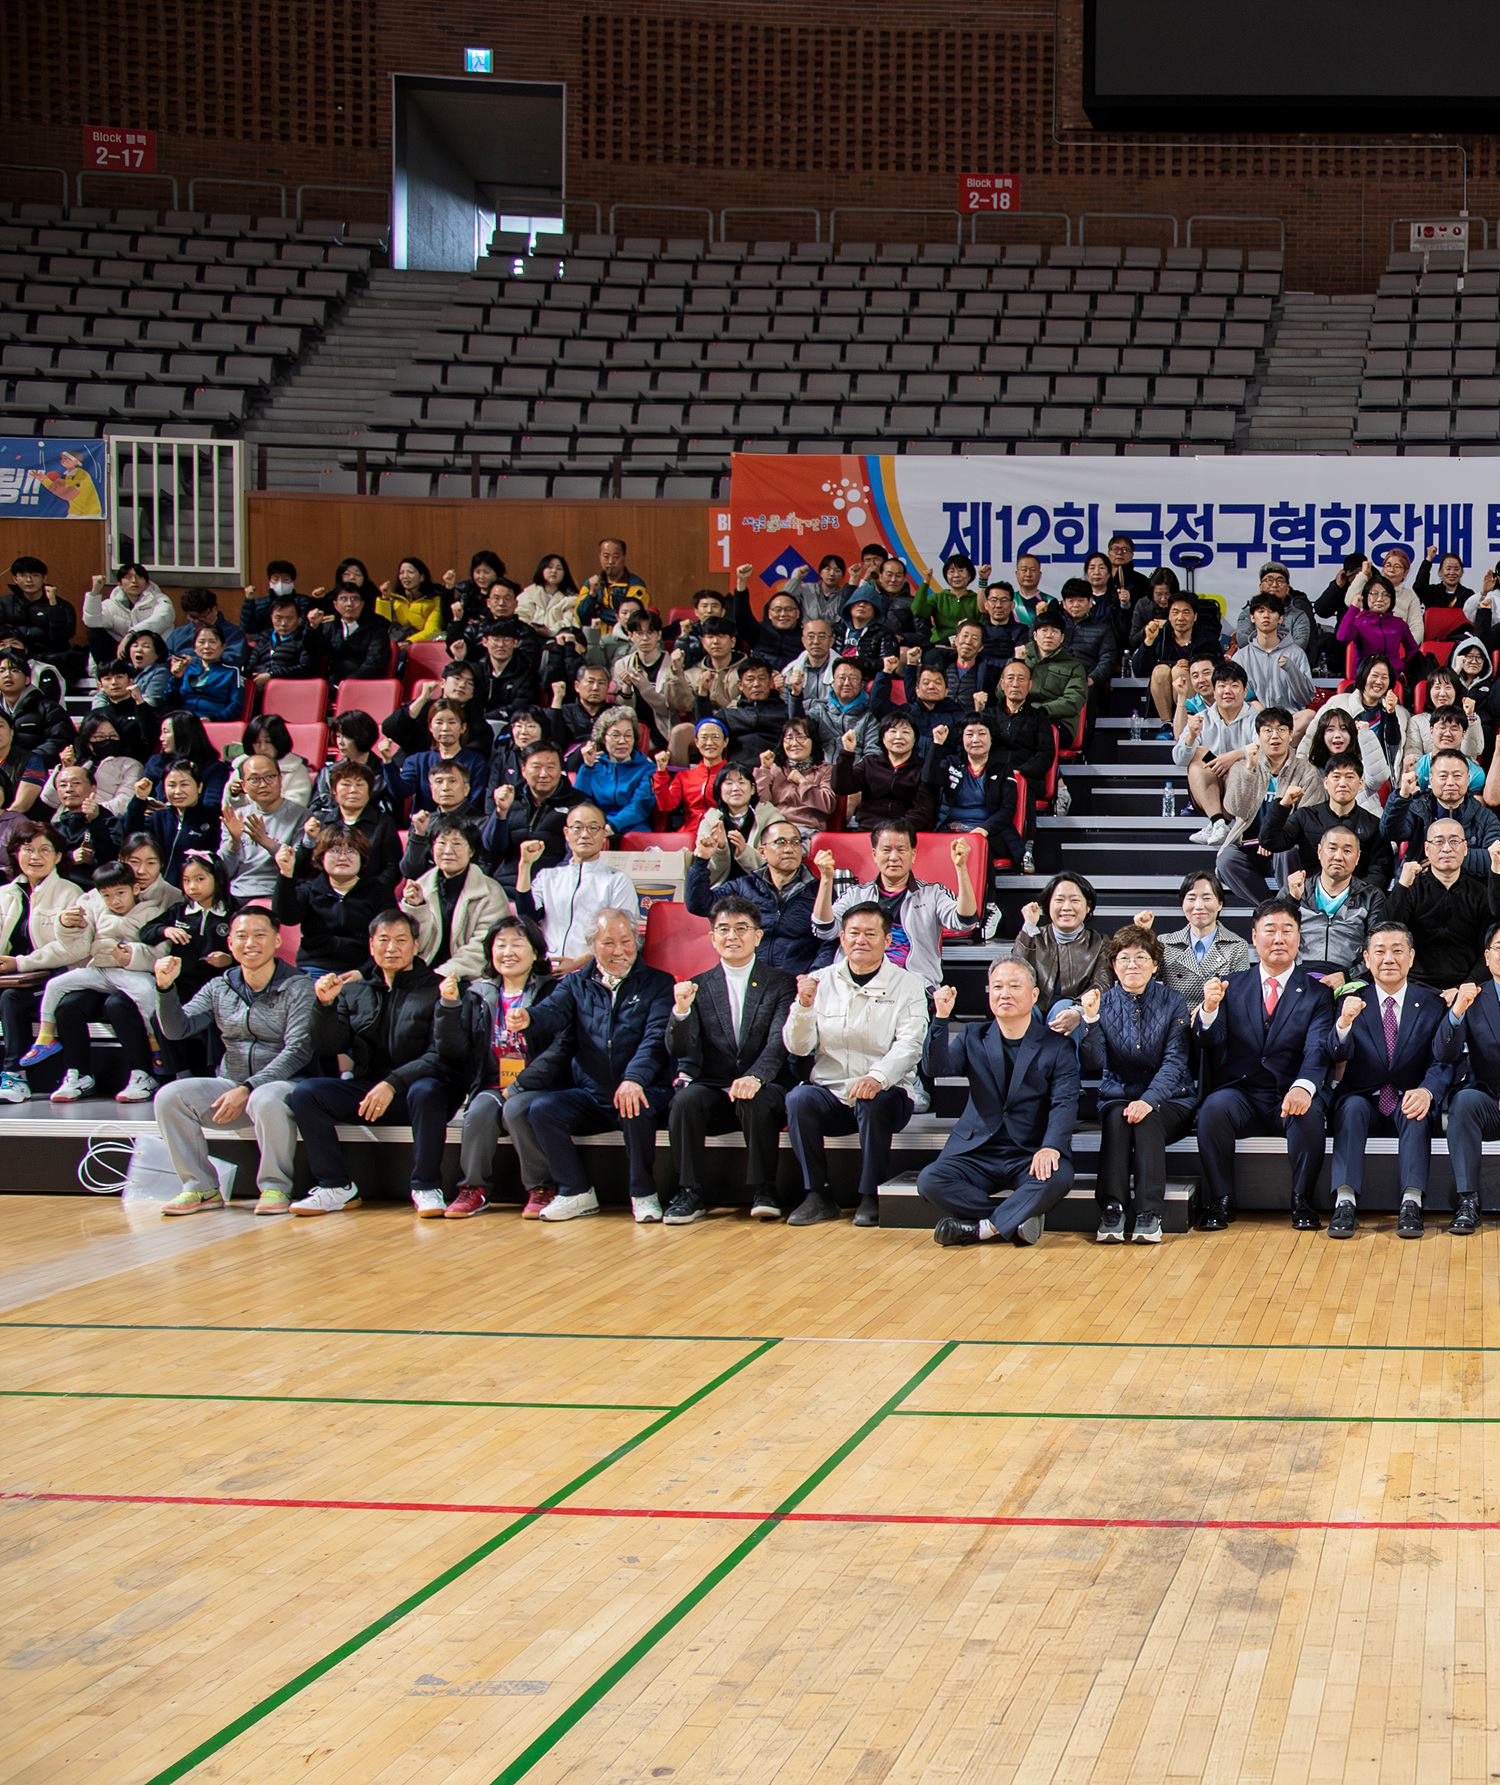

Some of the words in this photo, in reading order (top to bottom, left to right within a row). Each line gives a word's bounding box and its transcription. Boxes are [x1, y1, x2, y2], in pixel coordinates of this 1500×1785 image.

[92, 131, 122, 143] Block
[96, 146, 145, 168] 2-17
[966, 178, 992, 188] Block
[968, 191, 1010, 209] 2-18
[939, 501, 1100, 566] 제12회
[1112, 501, 1473, 569] 금정구협회장배
